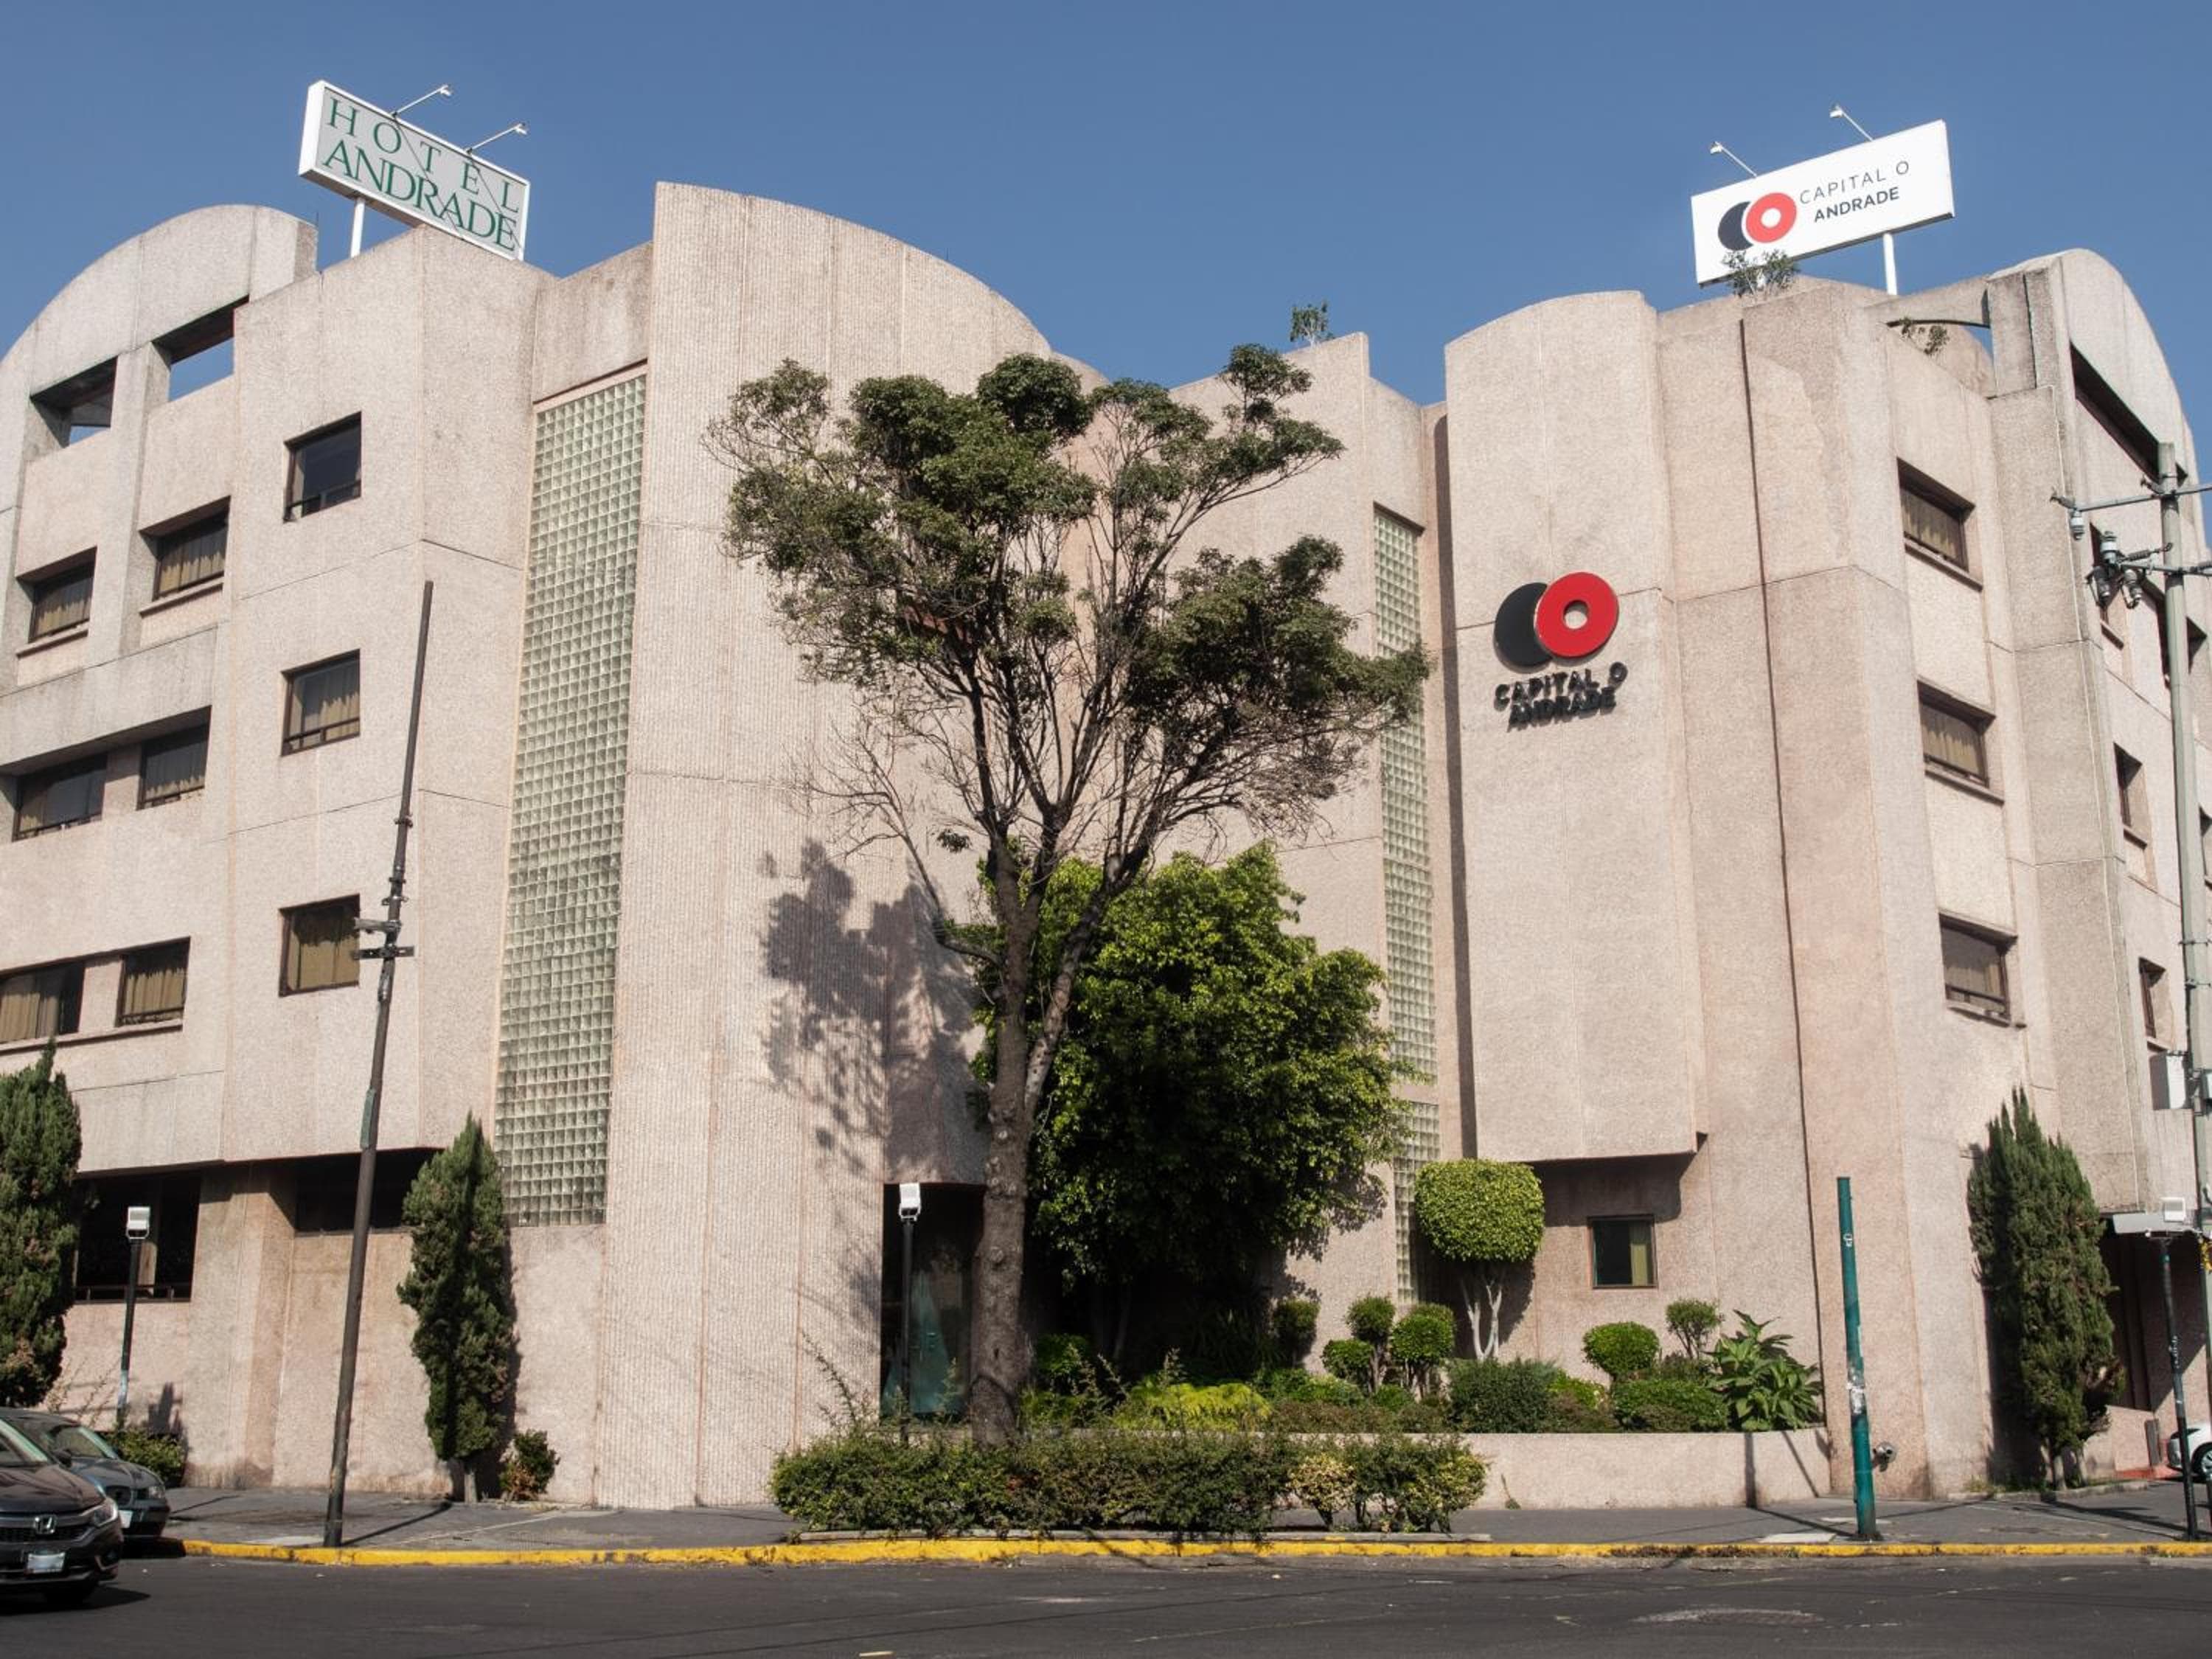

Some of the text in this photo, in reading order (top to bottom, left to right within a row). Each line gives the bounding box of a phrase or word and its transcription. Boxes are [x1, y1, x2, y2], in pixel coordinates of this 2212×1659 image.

[327, 97, 519, 214] HOTEL
[322, 139, 517, 252] ANDRADE
[1799, 160, 1910, 204] CAPITAL O
[1814, 187, 1900, 223] ANDRADE
[1495, 661, 1628, 709] CAPITAL O
